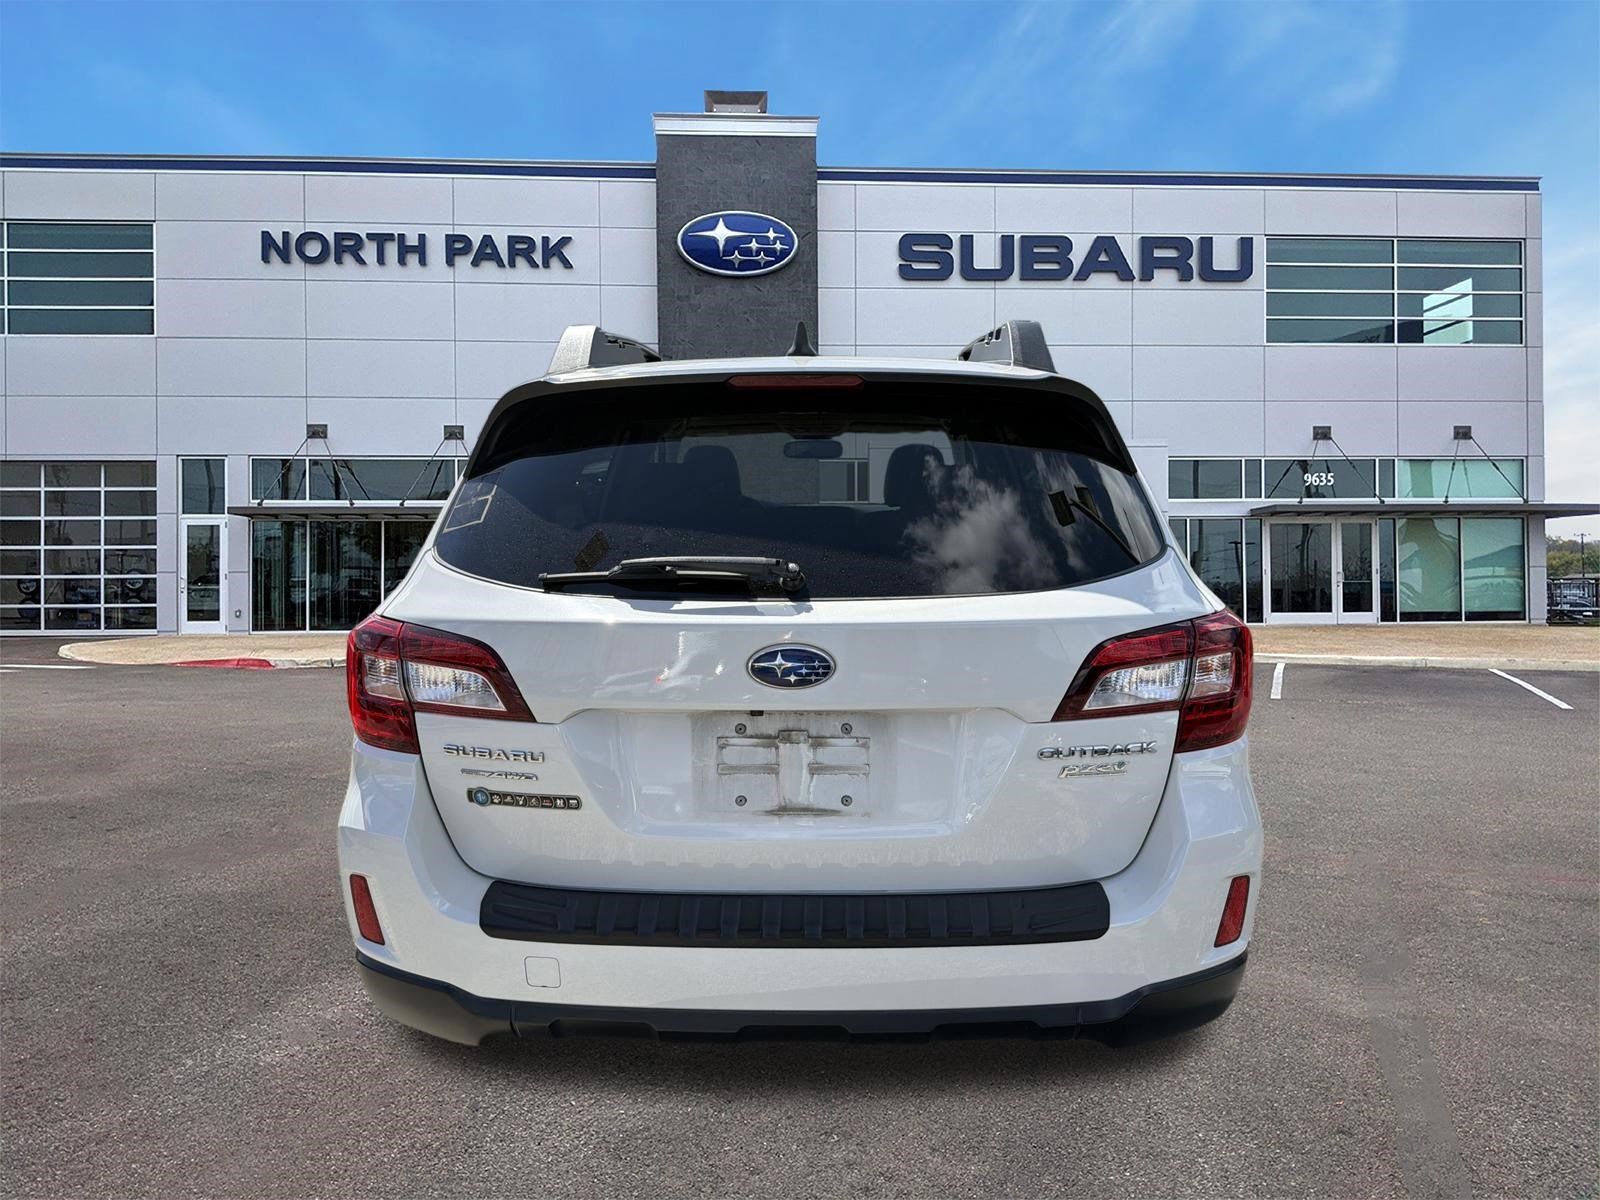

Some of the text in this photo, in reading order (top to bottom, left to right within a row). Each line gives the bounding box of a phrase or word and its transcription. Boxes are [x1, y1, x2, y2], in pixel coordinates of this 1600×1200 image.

[260, 230, 573, 269] NORTH PARK
[898, 232, 1254, 282] SUBARU
[1303, 472, 1335, 486] 9635
[443, 743, 545, 763] SUBARU
[1037, 740, 1157, 760] OUTBACK
